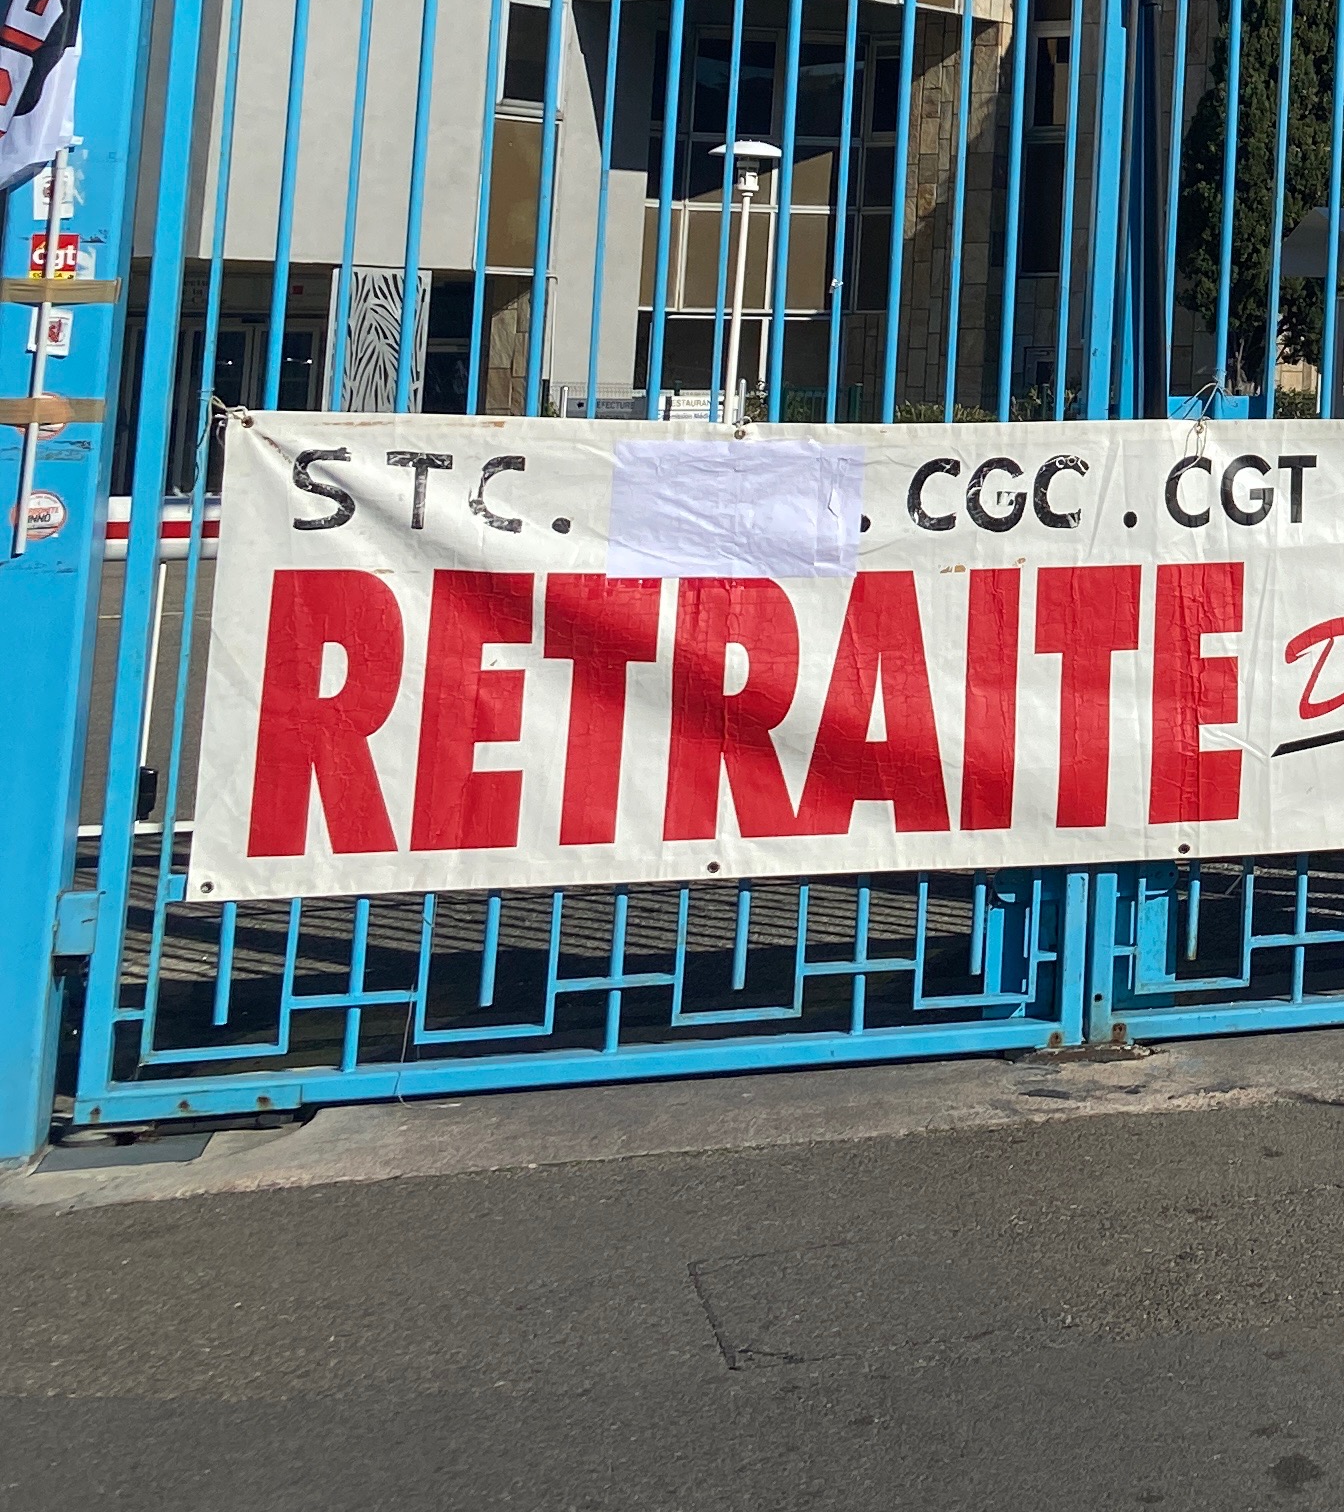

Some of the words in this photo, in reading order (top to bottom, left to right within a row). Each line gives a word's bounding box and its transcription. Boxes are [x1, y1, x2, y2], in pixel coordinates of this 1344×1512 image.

[906, 454, 1091, 533] CGC
[1164, 454, 1317, 529] CGT
[247, 561, 1245, 858] RETRAITE
